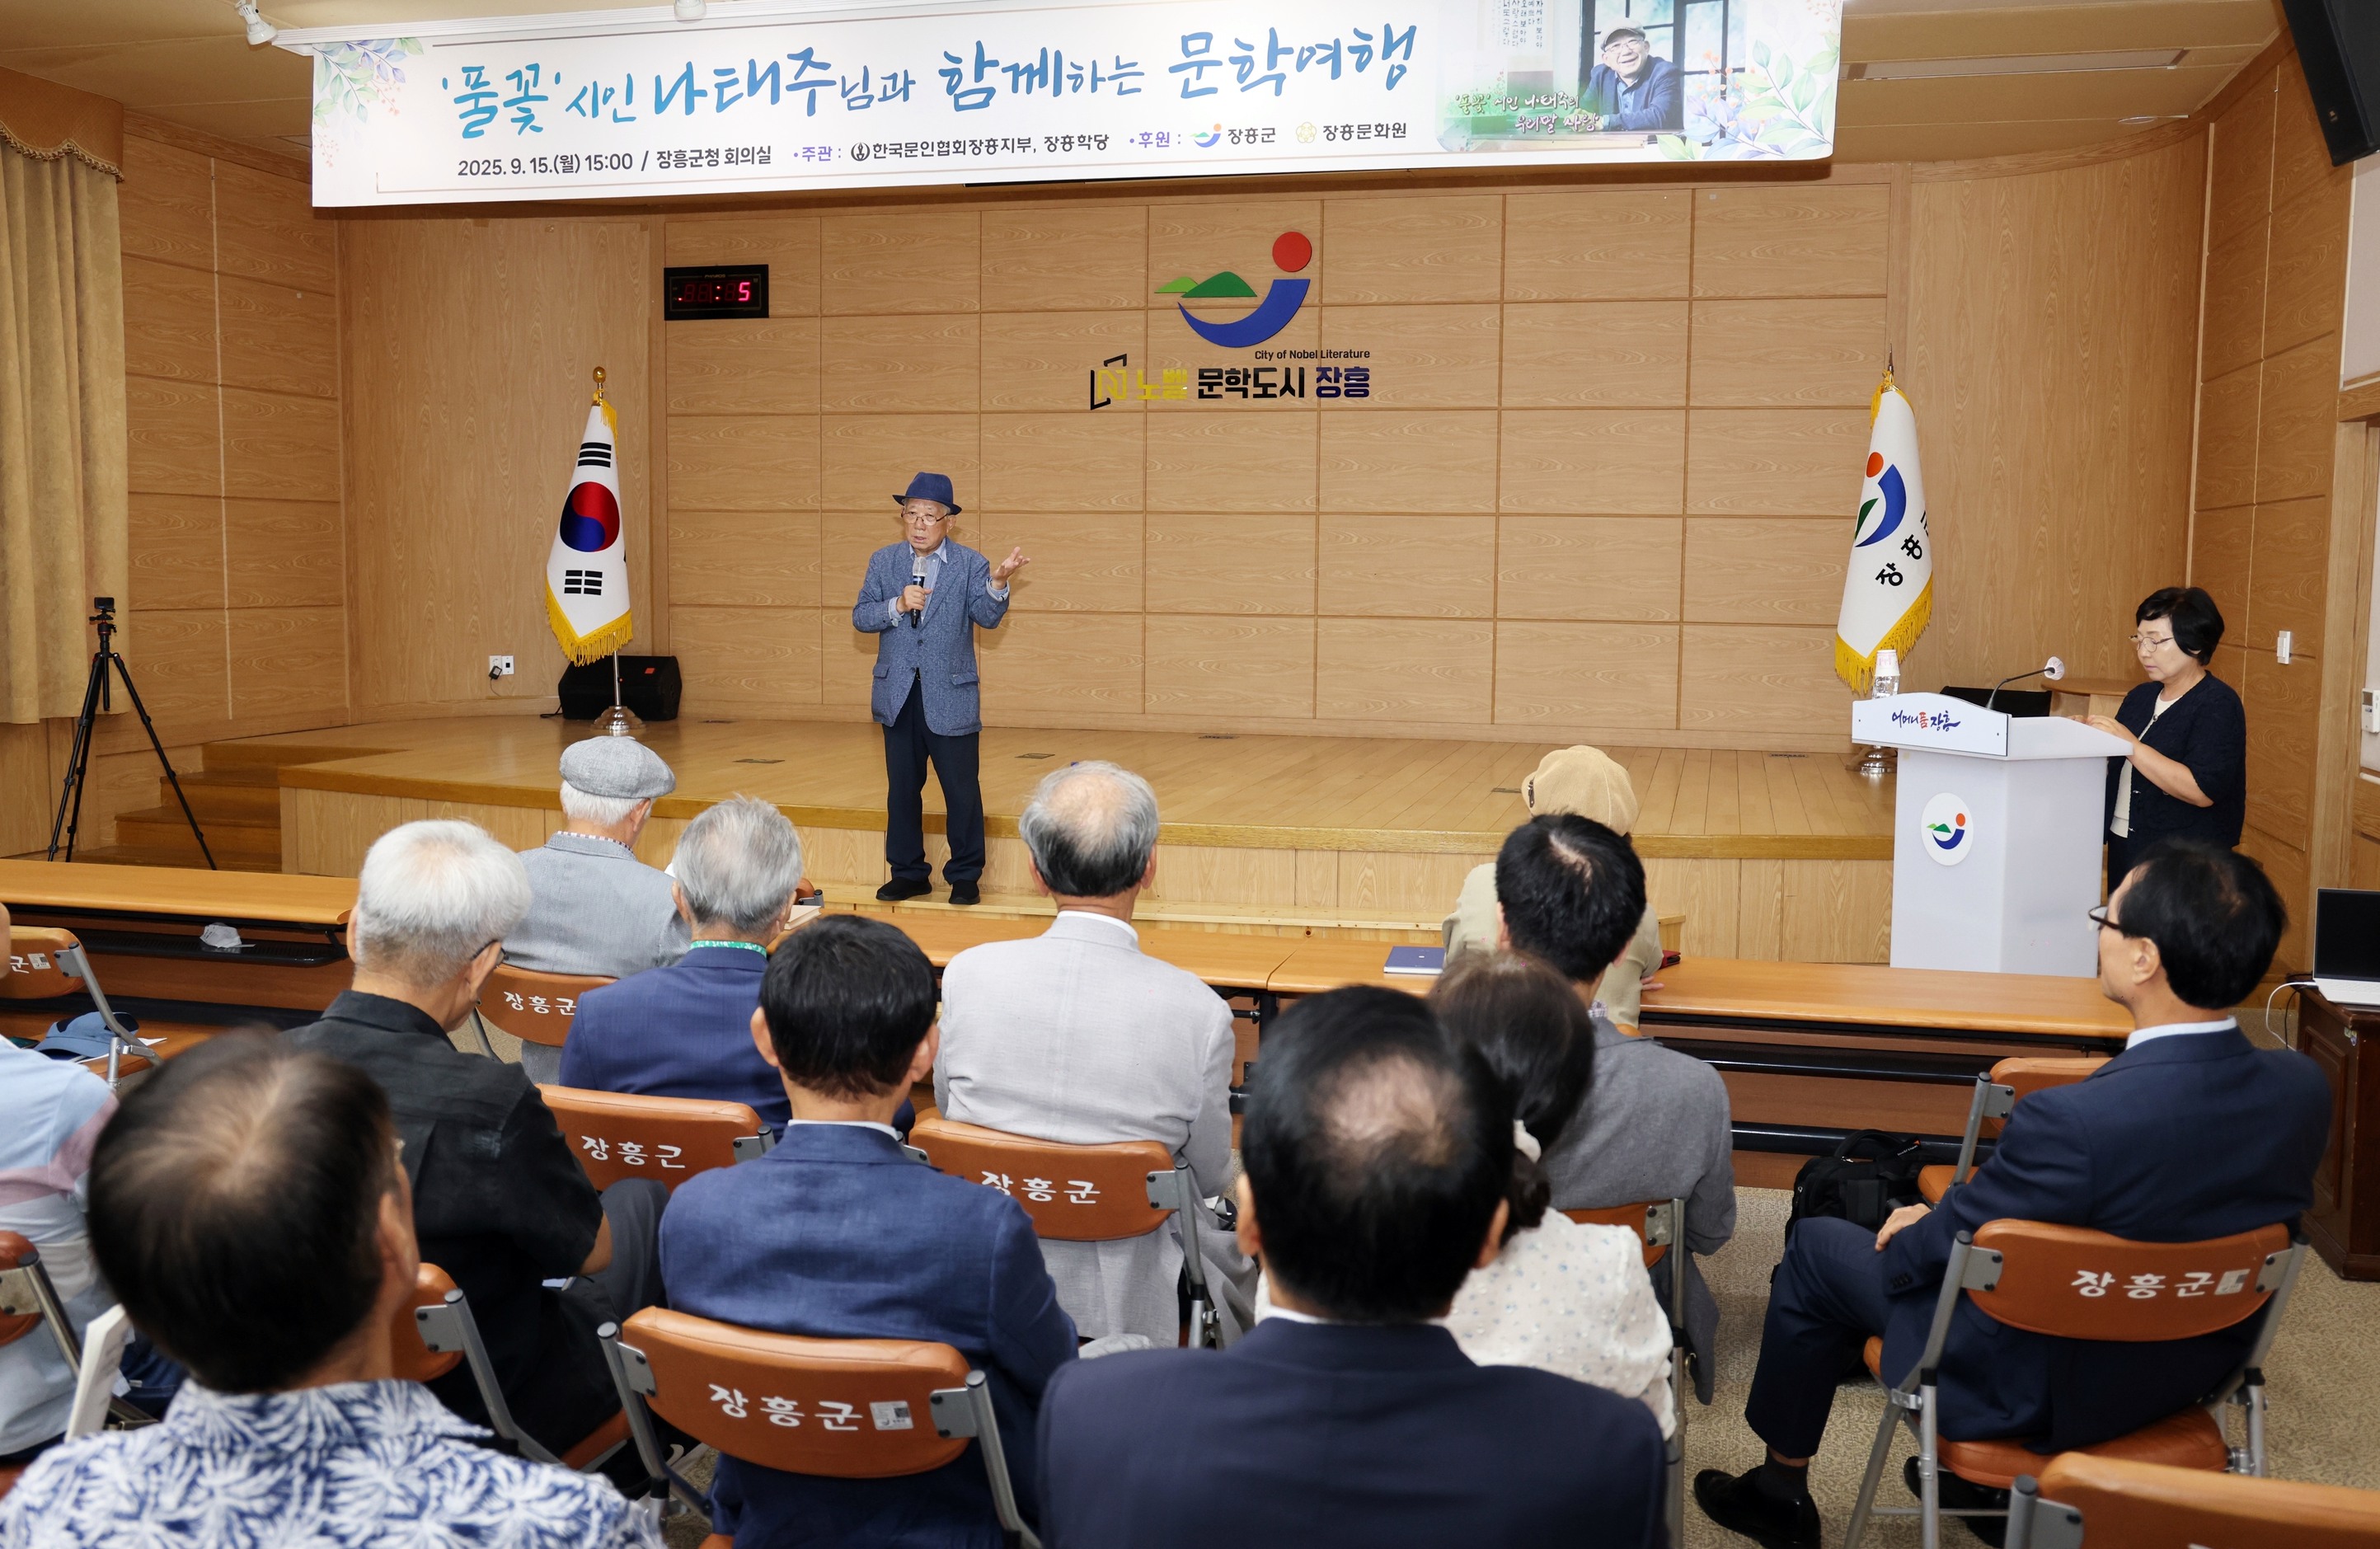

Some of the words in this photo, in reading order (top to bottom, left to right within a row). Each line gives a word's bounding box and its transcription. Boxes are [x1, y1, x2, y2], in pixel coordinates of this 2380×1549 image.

[566, 73, 636, 123] 시인
[938, 40, 1144, 111] 함께하는
[1169, 23, 1416, 99] 문학여행
[1494, 96, 1519, 110] 시인
[1228, 127, 1276, 144] 장흥군
[1323, 122, 1406, 141] 장흥문화원
[1515, 114, 1558, 134] 우리말
[1563, 113, 1600, 131] 사랑
[1044, 134, 1109, 153] 장흥학당
[585, 153, 632, 171] 15:00
[657, 148, 719, 169] 장흥군청
[725, 146, 772, 166] 회의실
[1255, 350, 1274, 361] City
[1277, 350, 1287, 359] of
[1289, 349, 1318, 359] Nobel
[1320, 349, 1370, 359] Literature
[1137, 368, 1188, 400] 노벨
[1199, 367, 1305, 399] 문학도시
[1317, 367, 1370, 398] 장흥
[504, 991, 576, 1016] 장흥군
[581, 1135, 686, 1169] 장흥군
[2071, 1270, 2216, 1299] 장흥군
[708, 1383, 863, 1431] 장흥군
